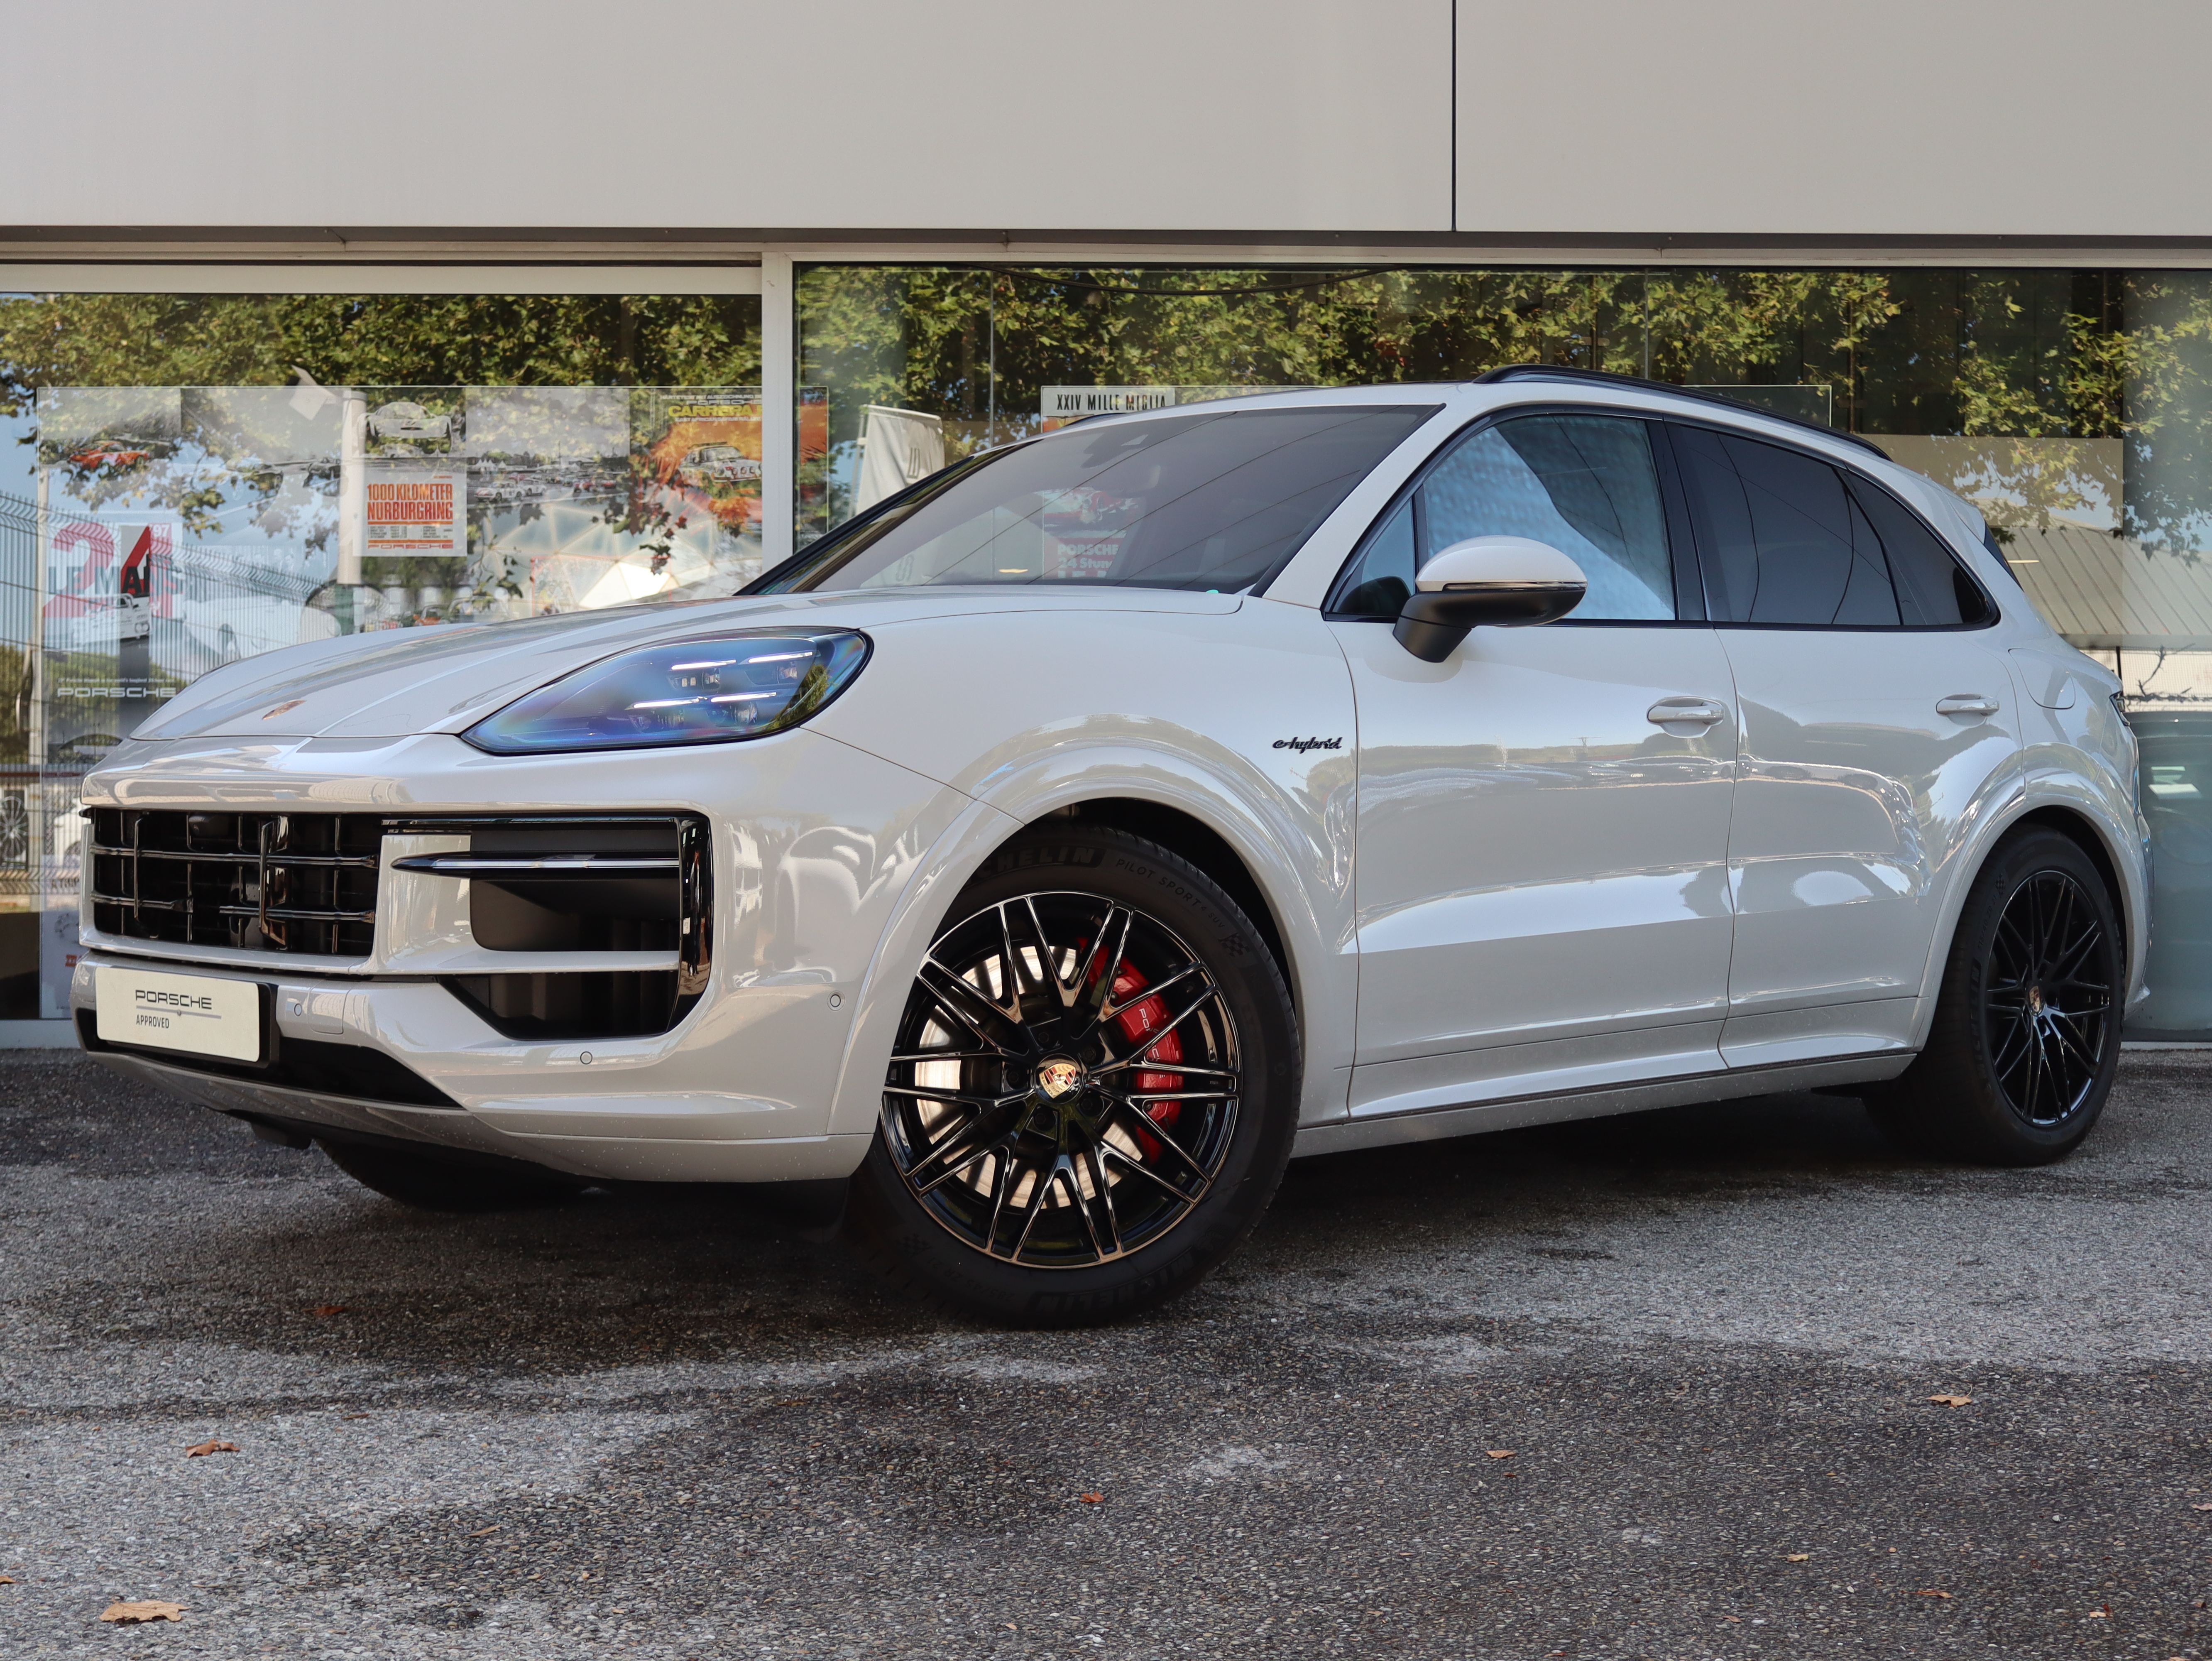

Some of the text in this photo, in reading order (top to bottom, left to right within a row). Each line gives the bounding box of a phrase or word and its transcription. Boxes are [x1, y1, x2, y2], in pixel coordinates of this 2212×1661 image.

[668, 405, 753, 416] CARRERA
[1057, 394, 1166, 411] XXIV MILLE MIGLIA
[367, 483, 453, 501] 1000 KILOMETER
[1057, 544, 1119, 555] PORSCHE
[1058, 557, 1077, 568] 24
[48, 566, 183, 596] LE MANS
[57, 687, 176, 698] PORSCHE
[1272, 737, 1343, 754] e-hybrid
[967, 846, 1095, 884] CHELIN
[1115, 858, 1156, 879] PILOT
[1158, 876, 1201, 906] SPORT
[1208, 912, 1226, 928] SUV
[135, 990, 212, 1009] PORSCHE
[136, 1014, 170, 1029] APPROVED
[1970, 965, 1988, 1080] MICHELIN
[1035, 1251, 1195, 1313] MICHELIN
